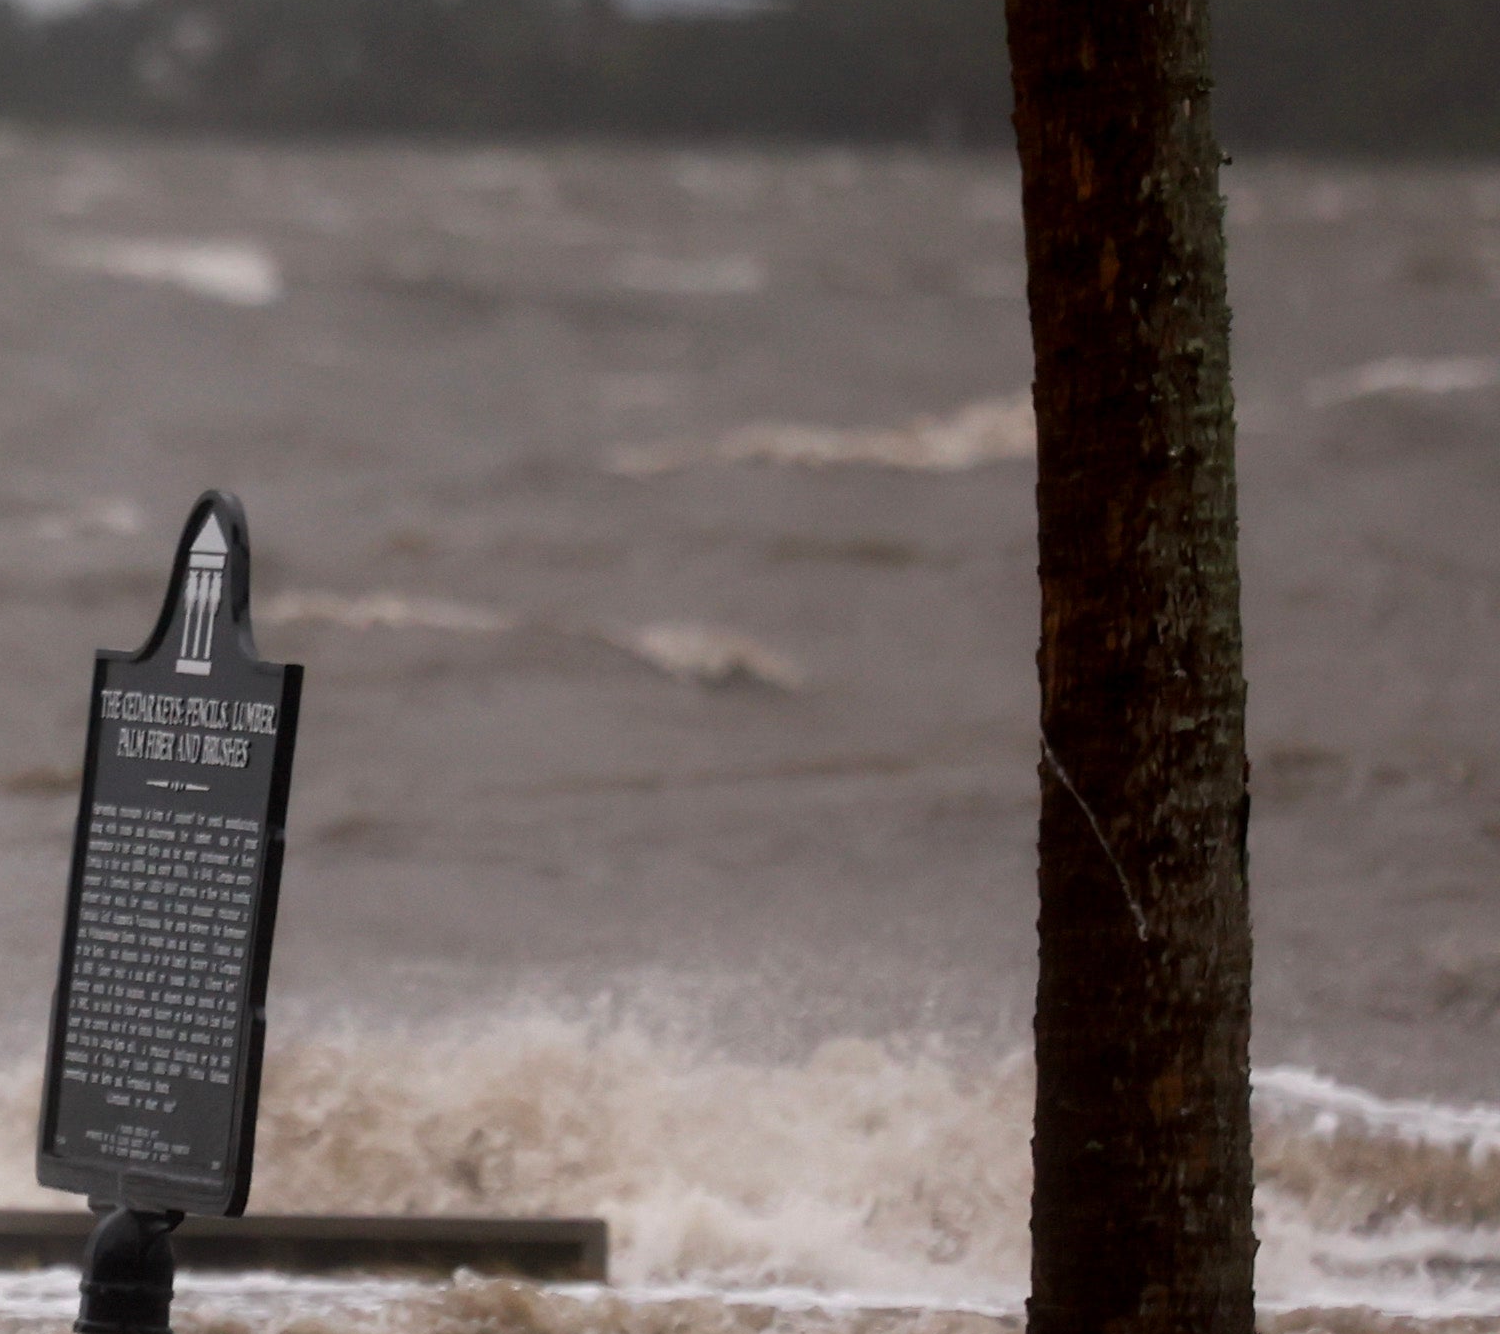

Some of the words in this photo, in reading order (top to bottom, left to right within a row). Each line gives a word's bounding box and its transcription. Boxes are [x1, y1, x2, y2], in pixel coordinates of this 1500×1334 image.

[117, 728, 145, 759] PALM
[145, 730, 175, 761] FIBER
[175, 733, 200, 763] AND
[201, 735, 250, 768] BRUSHES
